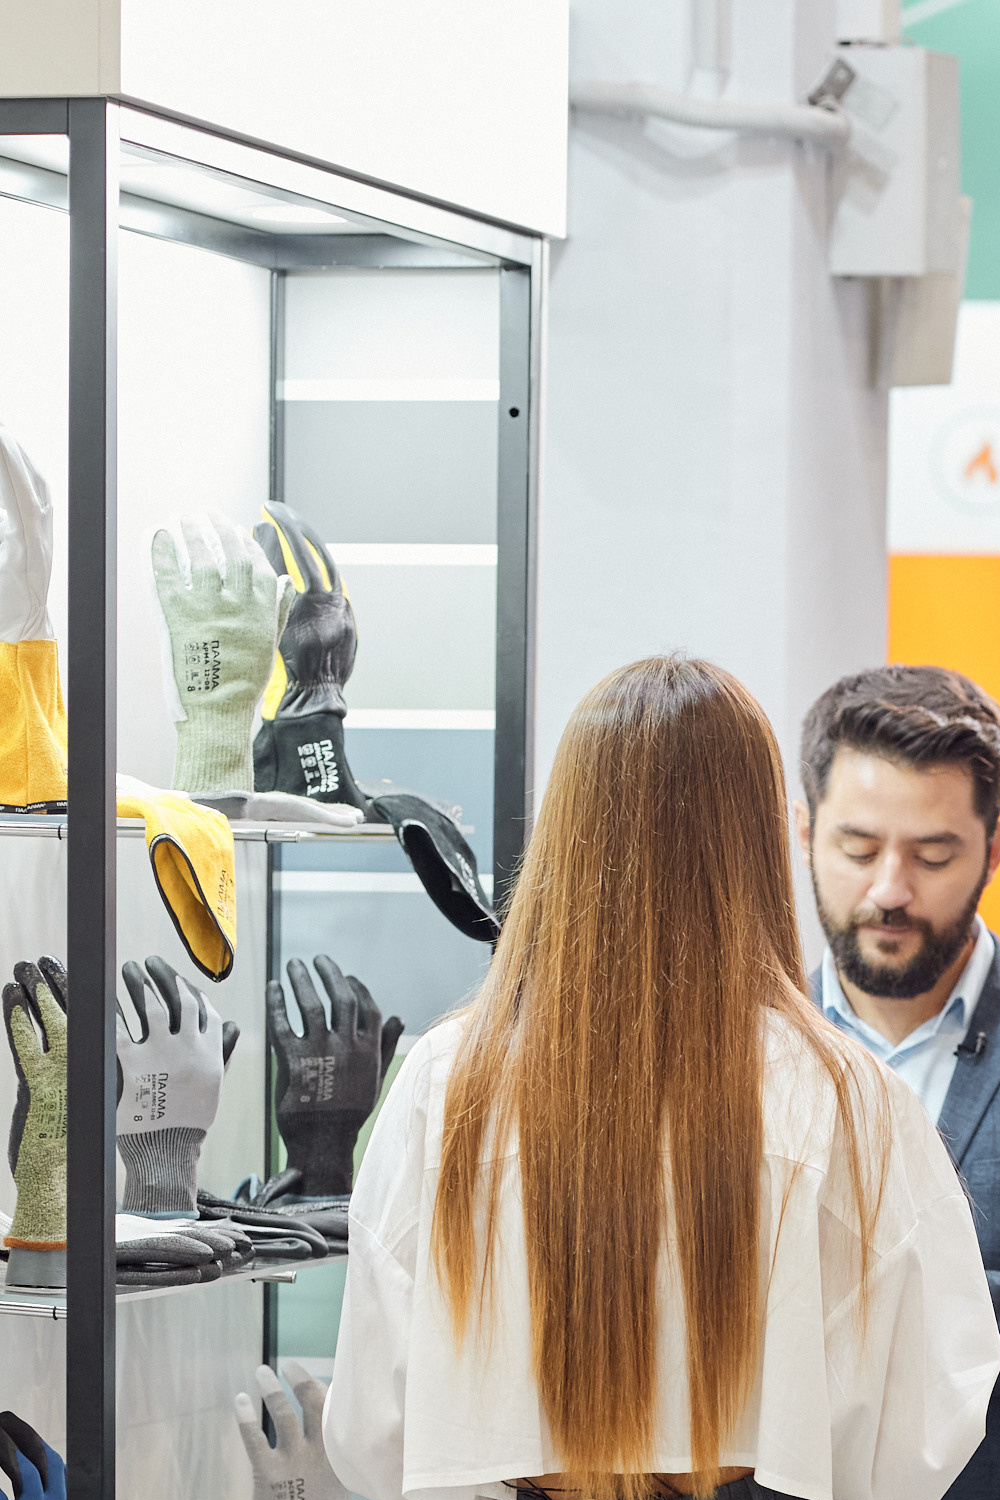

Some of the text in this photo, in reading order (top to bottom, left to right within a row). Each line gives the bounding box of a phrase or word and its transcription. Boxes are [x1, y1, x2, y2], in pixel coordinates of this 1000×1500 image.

[202, 641, 210, 665] АРМА
[211, 640, 221, 690] ПАЛМА
[320, 739, 339, 792] ПАЛМА
[157, 1072, 168, 1120] ПАЛМА
